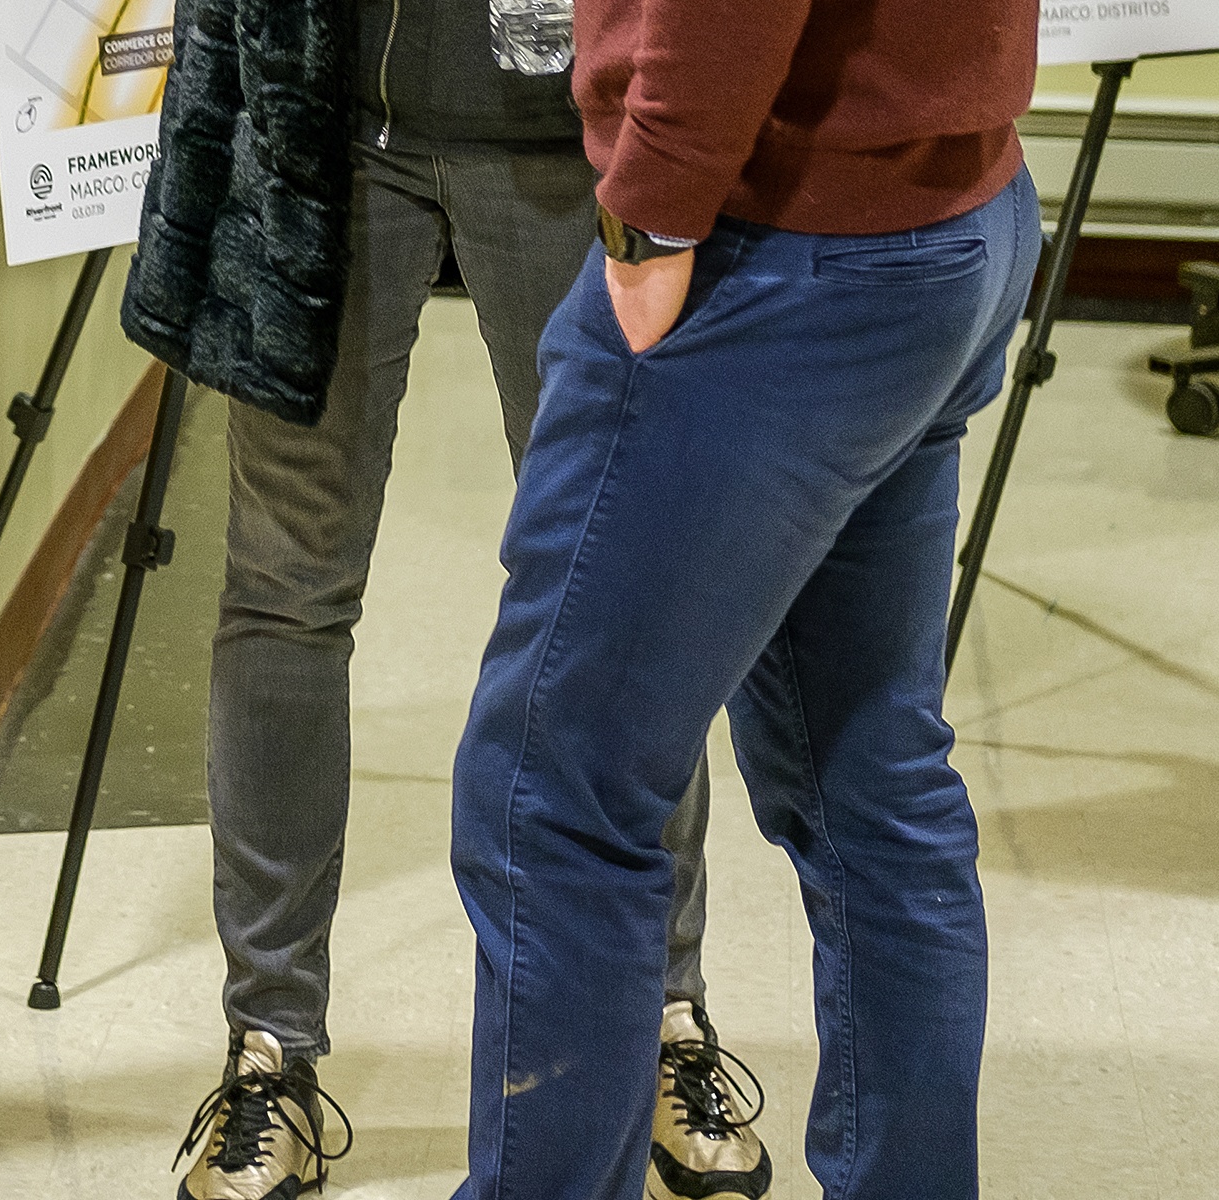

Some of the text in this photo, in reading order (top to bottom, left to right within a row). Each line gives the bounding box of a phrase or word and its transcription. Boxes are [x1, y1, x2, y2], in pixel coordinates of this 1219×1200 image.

[1097, 0, 1170, 20] DISTRITOS
[104, 34, 156, 54] COMMERCE
[104, 50, 155, 70] CORREDOR
[70, 175, 128, 201] MARCO:
